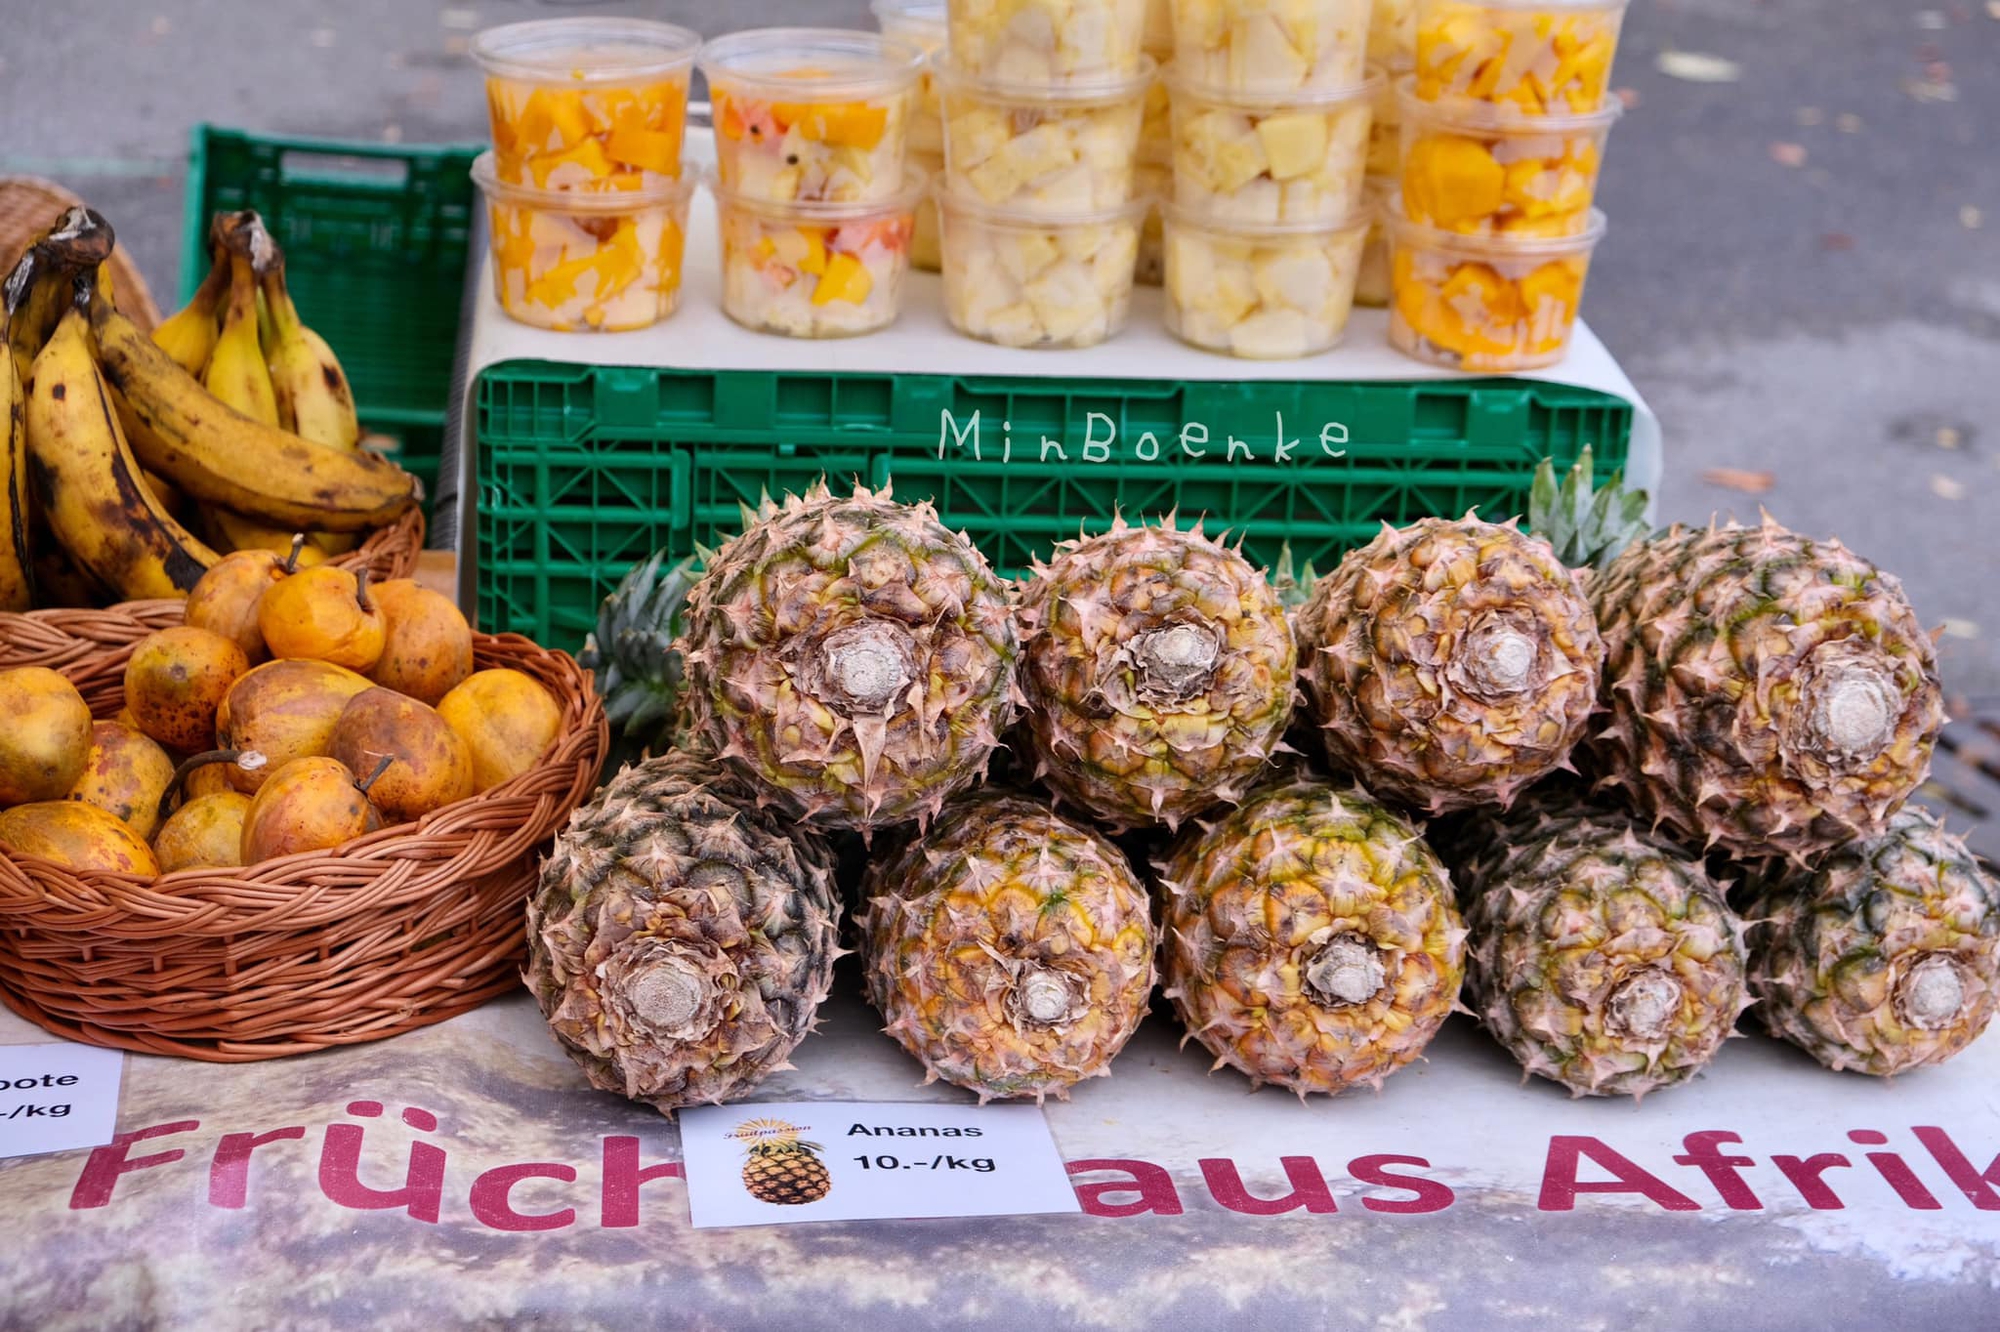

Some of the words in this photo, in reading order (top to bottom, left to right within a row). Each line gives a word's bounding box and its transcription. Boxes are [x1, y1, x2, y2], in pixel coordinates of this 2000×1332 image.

[847, 1123, 984, 1138] Ananas
[853, 1154, 996, 1173] 10.-/kg
[1064, 1154, 1456, 1218] aus
